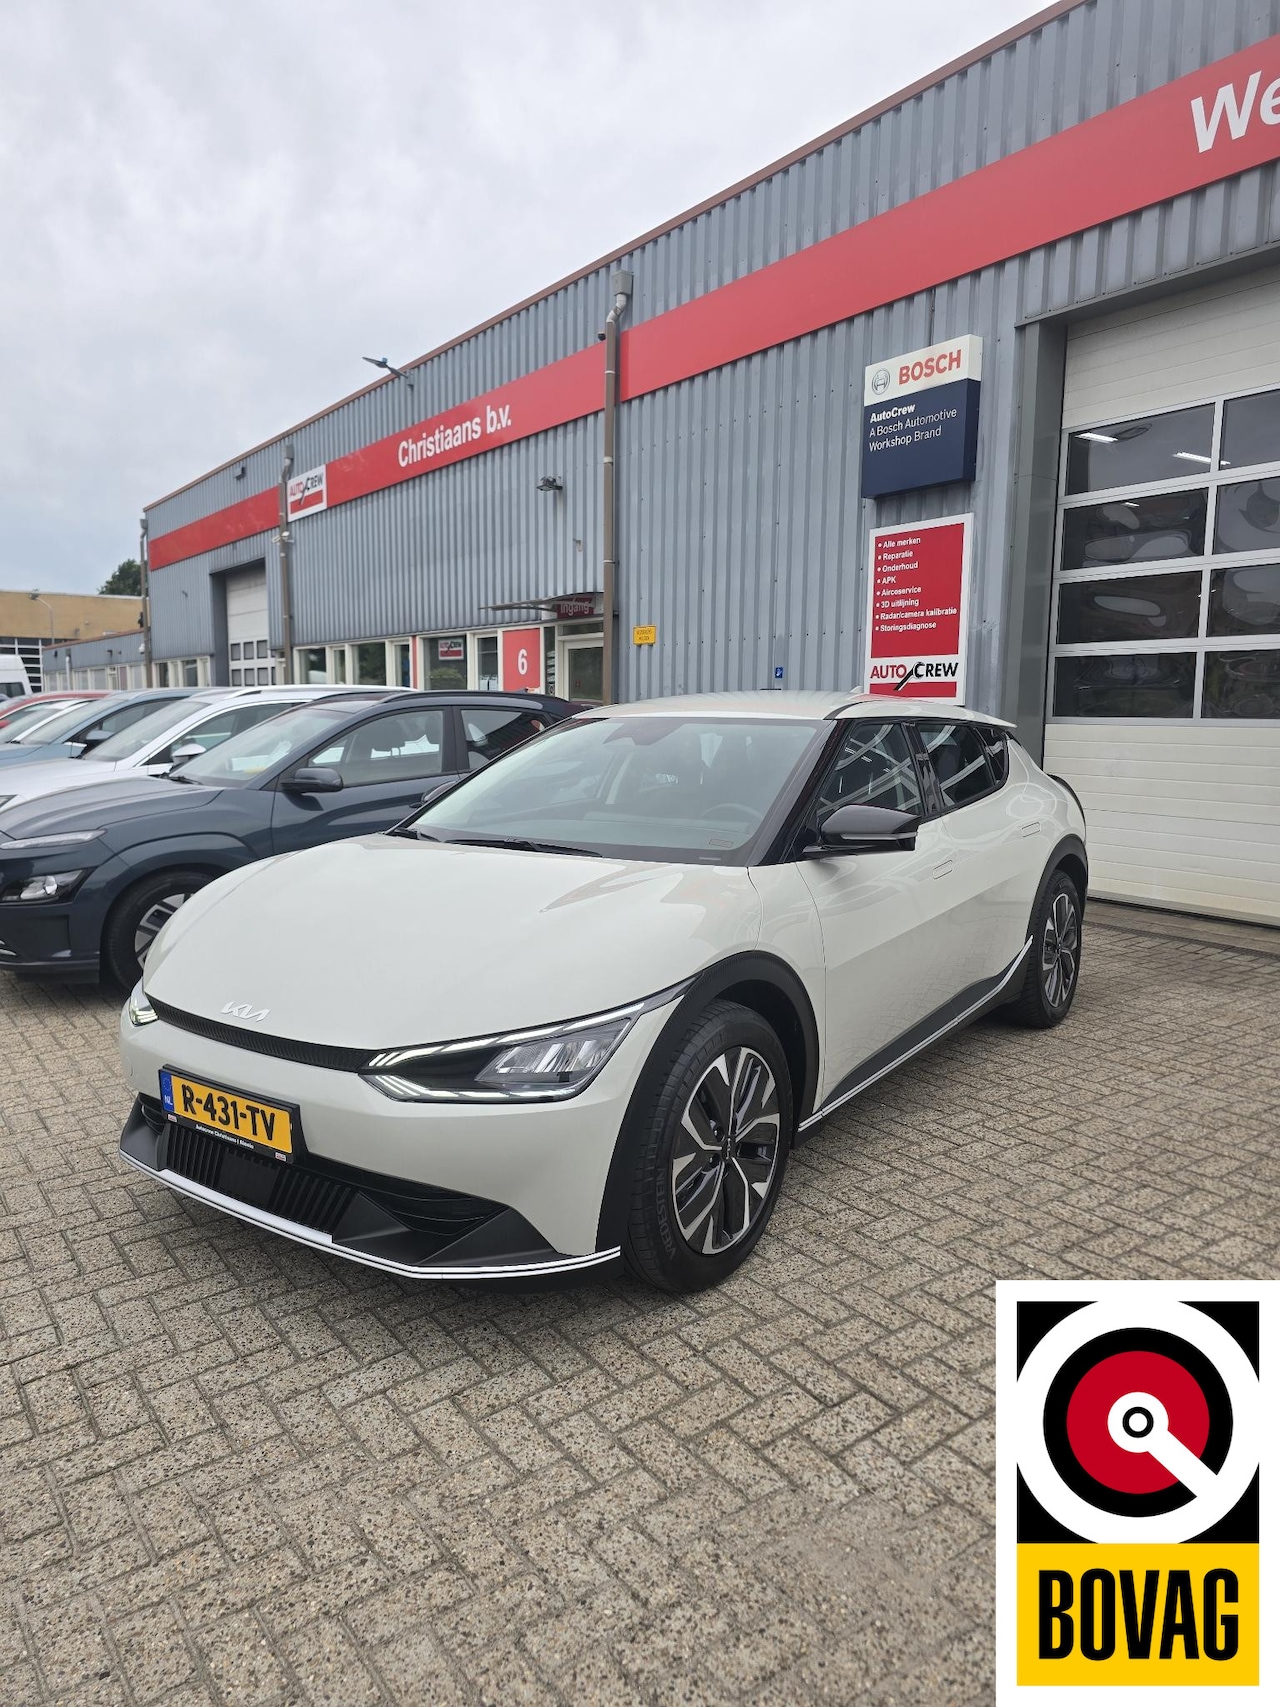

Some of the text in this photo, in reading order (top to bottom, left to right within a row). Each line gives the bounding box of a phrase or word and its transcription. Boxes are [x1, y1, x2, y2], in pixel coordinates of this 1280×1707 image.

[898, 349, 961, 385] BOSCH
[869, 404, 915, 423] AutoCrew
[869, 408, 957, 438] A Bosch Automotive
[398, 404, 512, 468] Christiaans b.v.
[869, 425, 942, 452] Workshop Brand
[882, 537, 921, 549] Alle merken
[882, 550, 914, 561] Reparatie
[882, 561, 919, 572] Onderhoud
[881, 576, 897, 584] APK
[881, 586, 922, 596] Aircoservice
[880, 598, 919, 608] 3D uitlijning
[925, 607, 957, 617] kalibratie
[880, 621, 937, 632] Storingsdiagnose
[517, 648, 528, 675] 6
[870, 661, 959, 679] AUTO CREW
[164, 1094, 174, 1106] NL
[181, 1084, 276, 1141] R-431-TV
